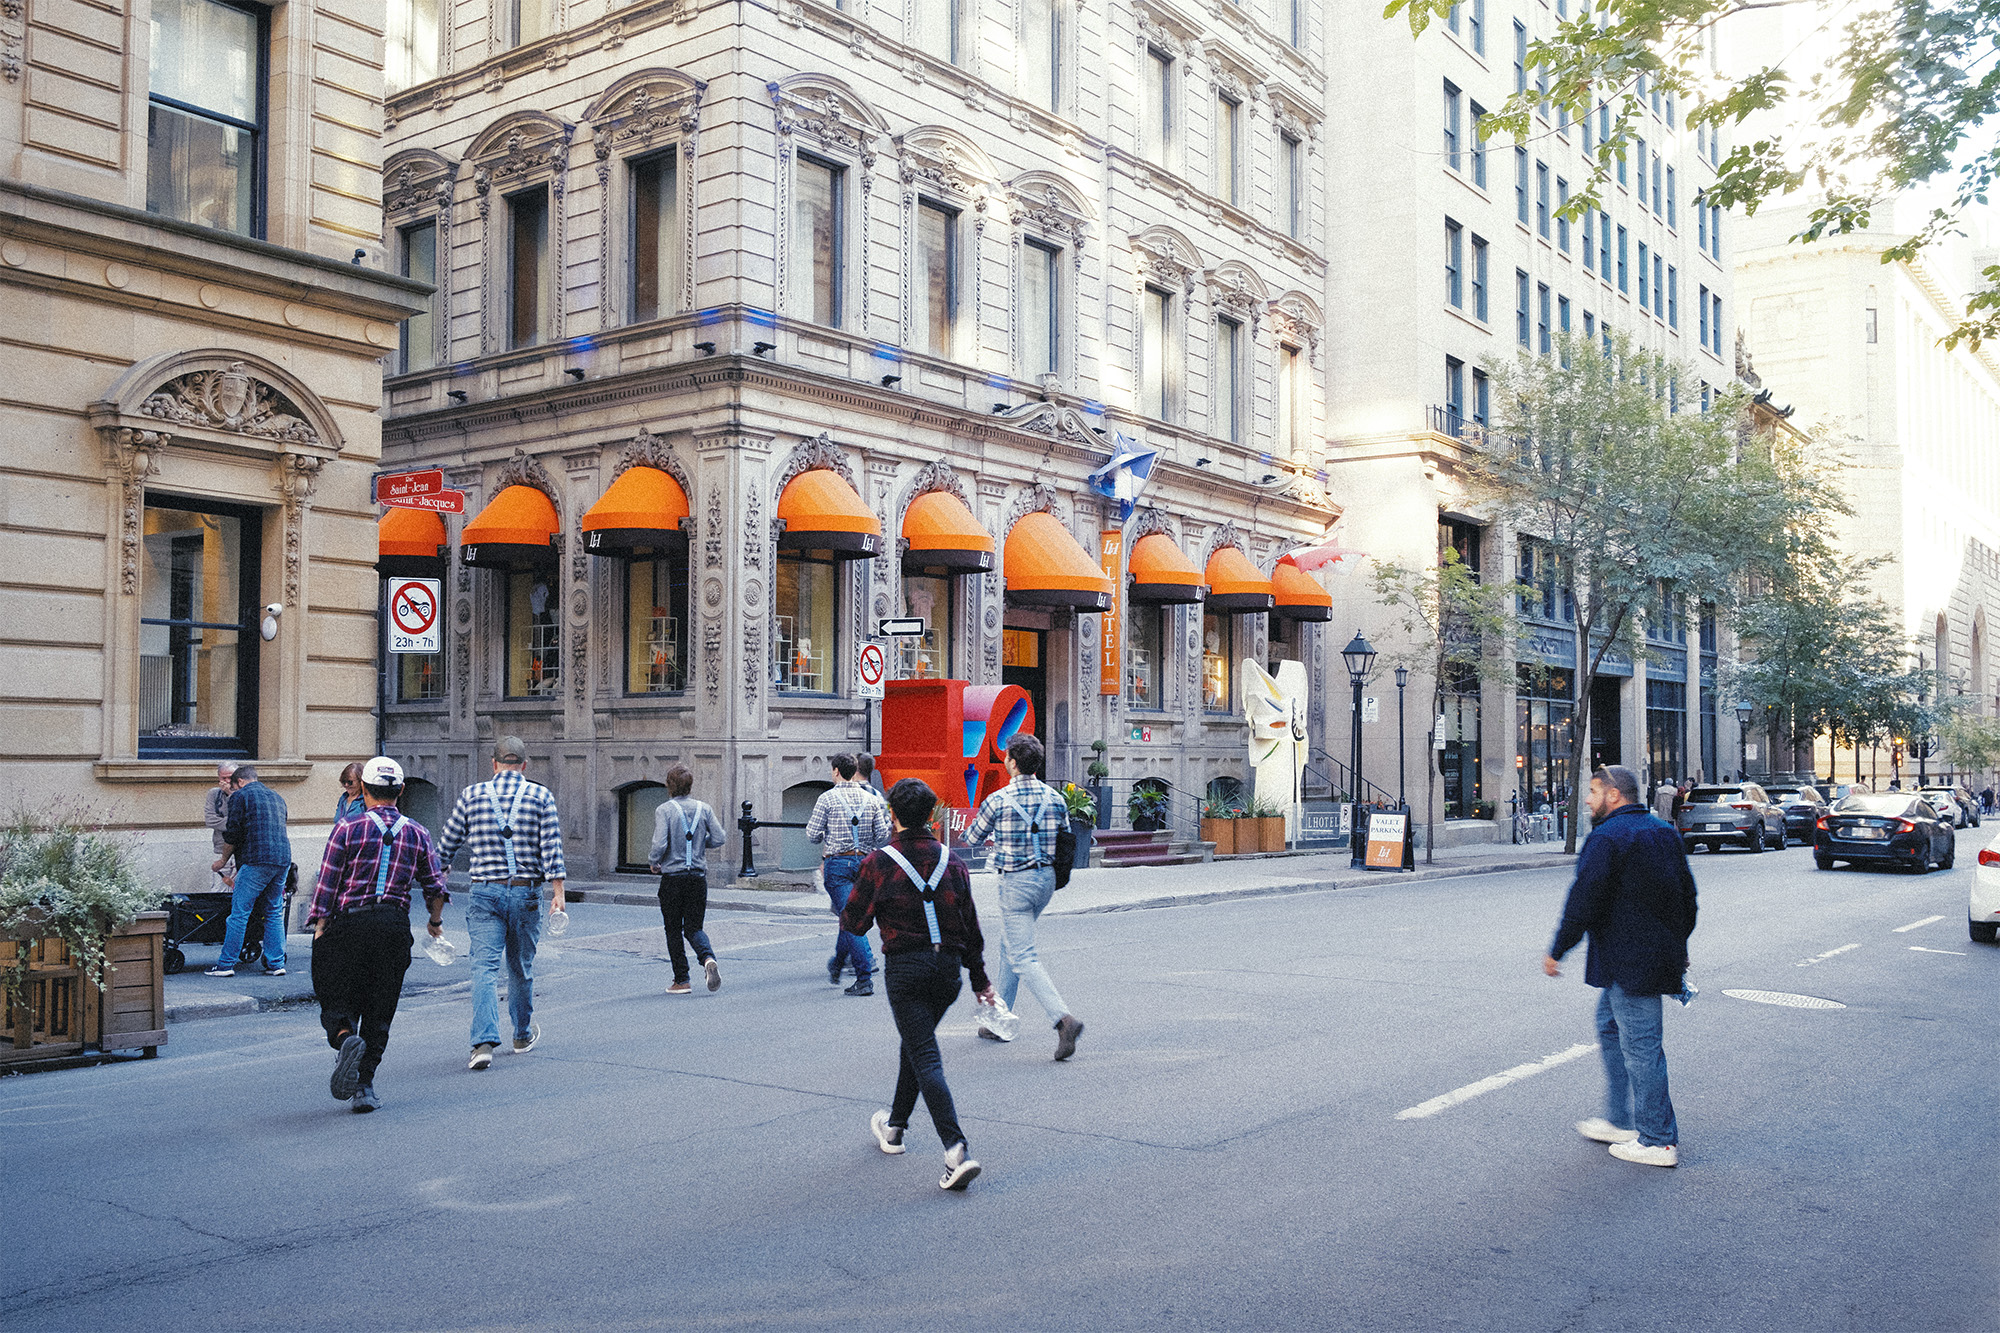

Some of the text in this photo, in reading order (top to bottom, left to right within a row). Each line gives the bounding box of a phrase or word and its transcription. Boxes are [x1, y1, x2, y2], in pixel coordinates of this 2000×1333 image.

[389, 481, 429, 496] Saint-Jean
[861, 533, 875, 552] LH
[1103, 539, 1120, 555] LH
[978, 551, 990, 568] LH
[395, 636, 414, 648] 23h
[422, 636, 434, 648] 7h
[861, 685, 872, 695] 23h
[1367, 697, 1374, 707] P
[950, 809, 968, 832] LH
[1307, 816, 1339, 829] LHOTEL
[1376, 818, 1400, 826] VALET
[1370, 826, 1403, 835] PARKING
